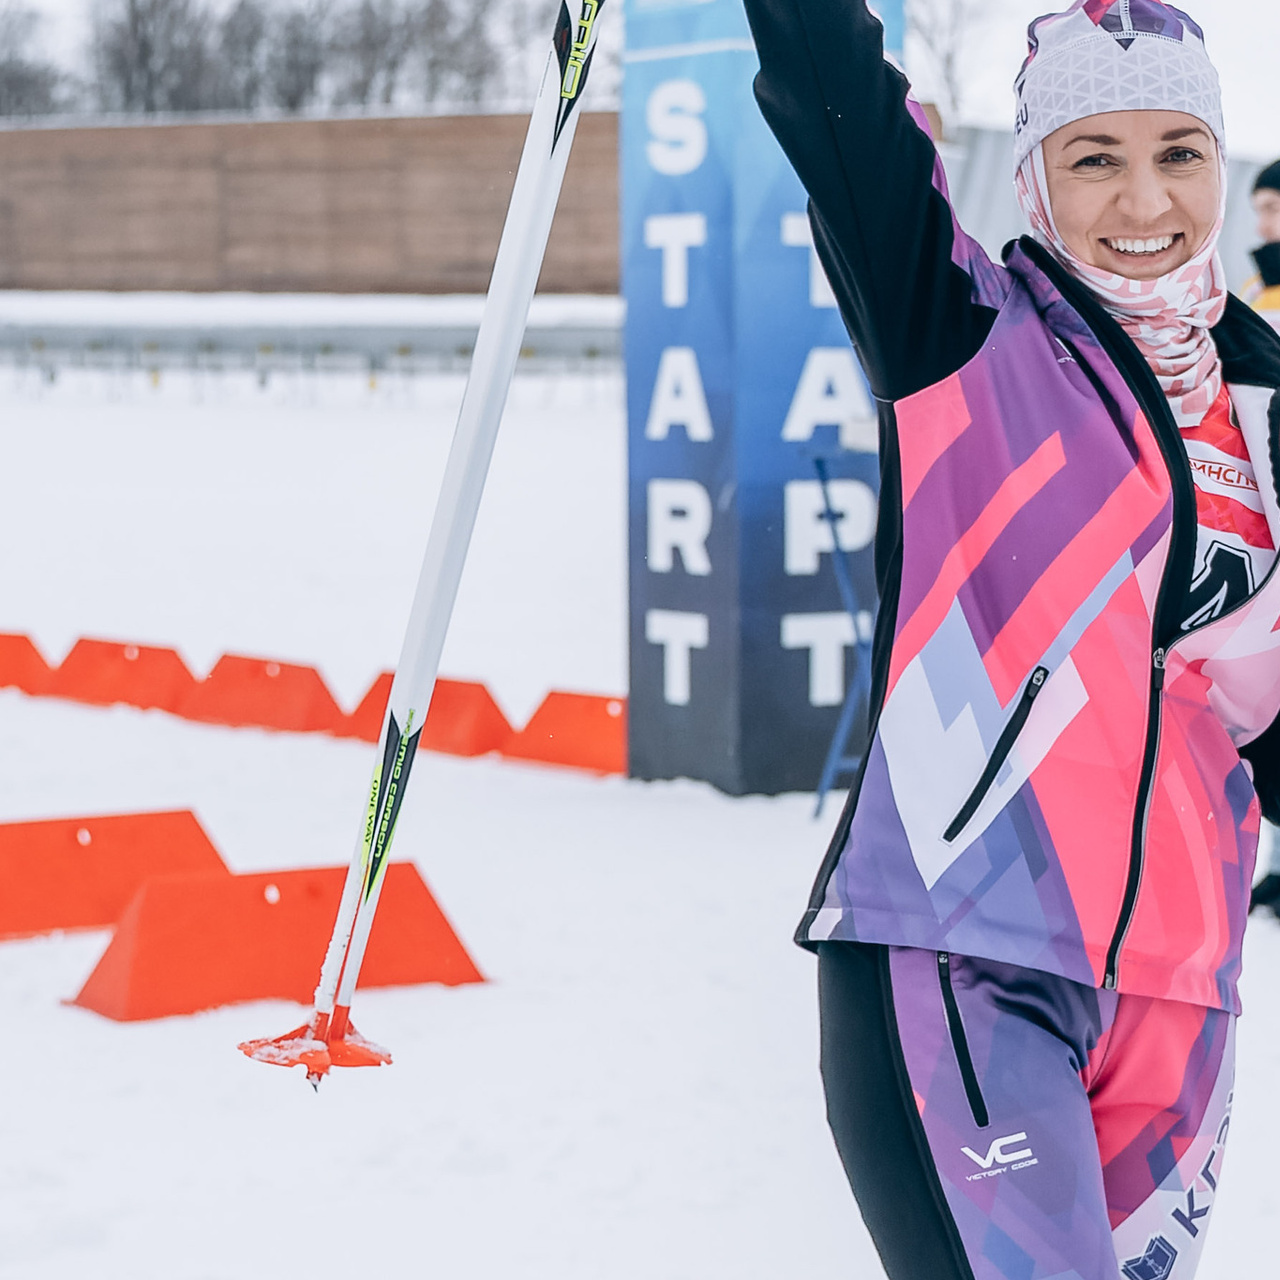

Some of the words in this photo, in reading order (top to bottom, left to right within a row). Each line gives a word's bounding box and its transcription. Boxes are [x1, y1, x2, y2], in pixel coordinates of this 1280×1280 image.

[644, 78, 714, 706] START
[368, 779, 379, 809] ONE
[363, 809, 376, 845] WAY
[965, 1166, 1008, 1182] VICTORY
[1010, 1157, 1039, 1171] CODE
